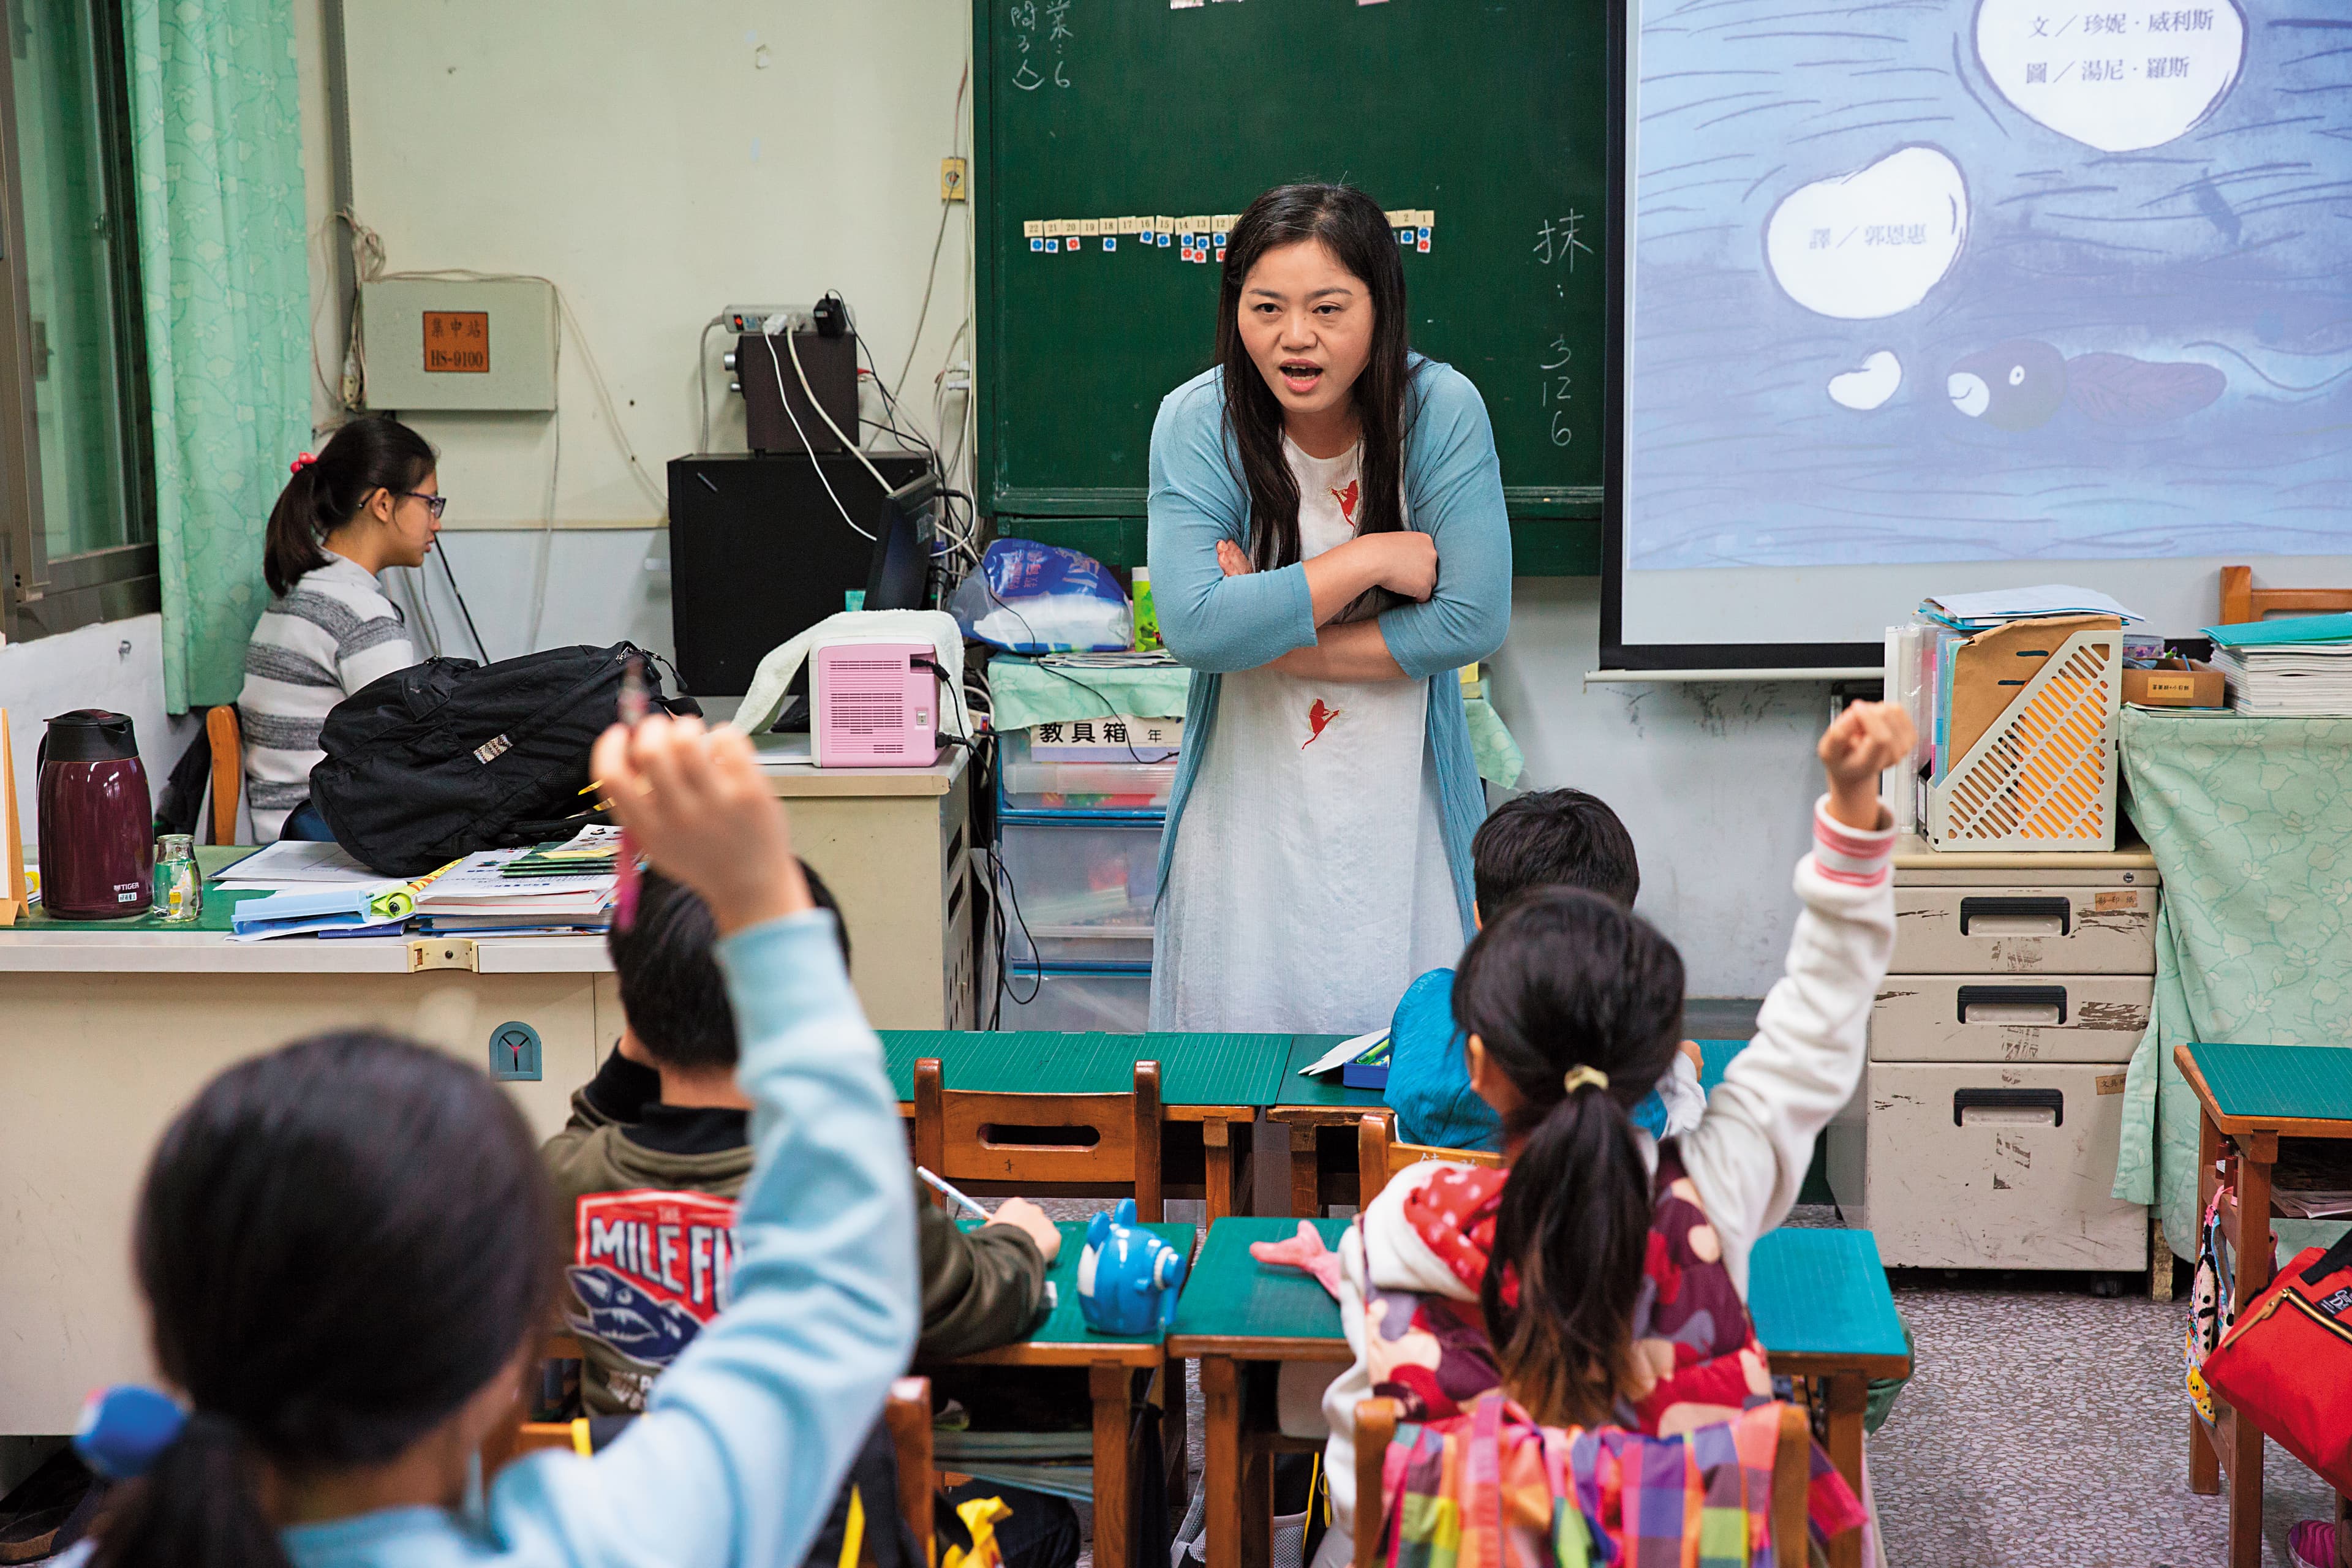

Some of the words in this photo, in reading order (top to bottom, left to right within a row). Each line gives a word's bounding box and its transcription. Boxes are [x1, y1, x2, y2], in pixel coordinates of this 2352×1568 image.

[1048, 224, 1057, 232] 21
[1066, 223, 1076, 232] 20
[1085, 223, 1095, 232] 19
[1104, 221, 1113, 230] 18
[1123, 221, 1132, 229] 17
[1141, 219, 1150, 228] 16
[1179, 221, 1188, 230] 14
[431, 350, 483, 368] HS-9100
[1039, 722, 1126, 743] 教具箱
[1147, 729, 1162, 743] 年
[121, 882, 139, 891] TIGER
[590, 1218, 684, 1294] MILE
